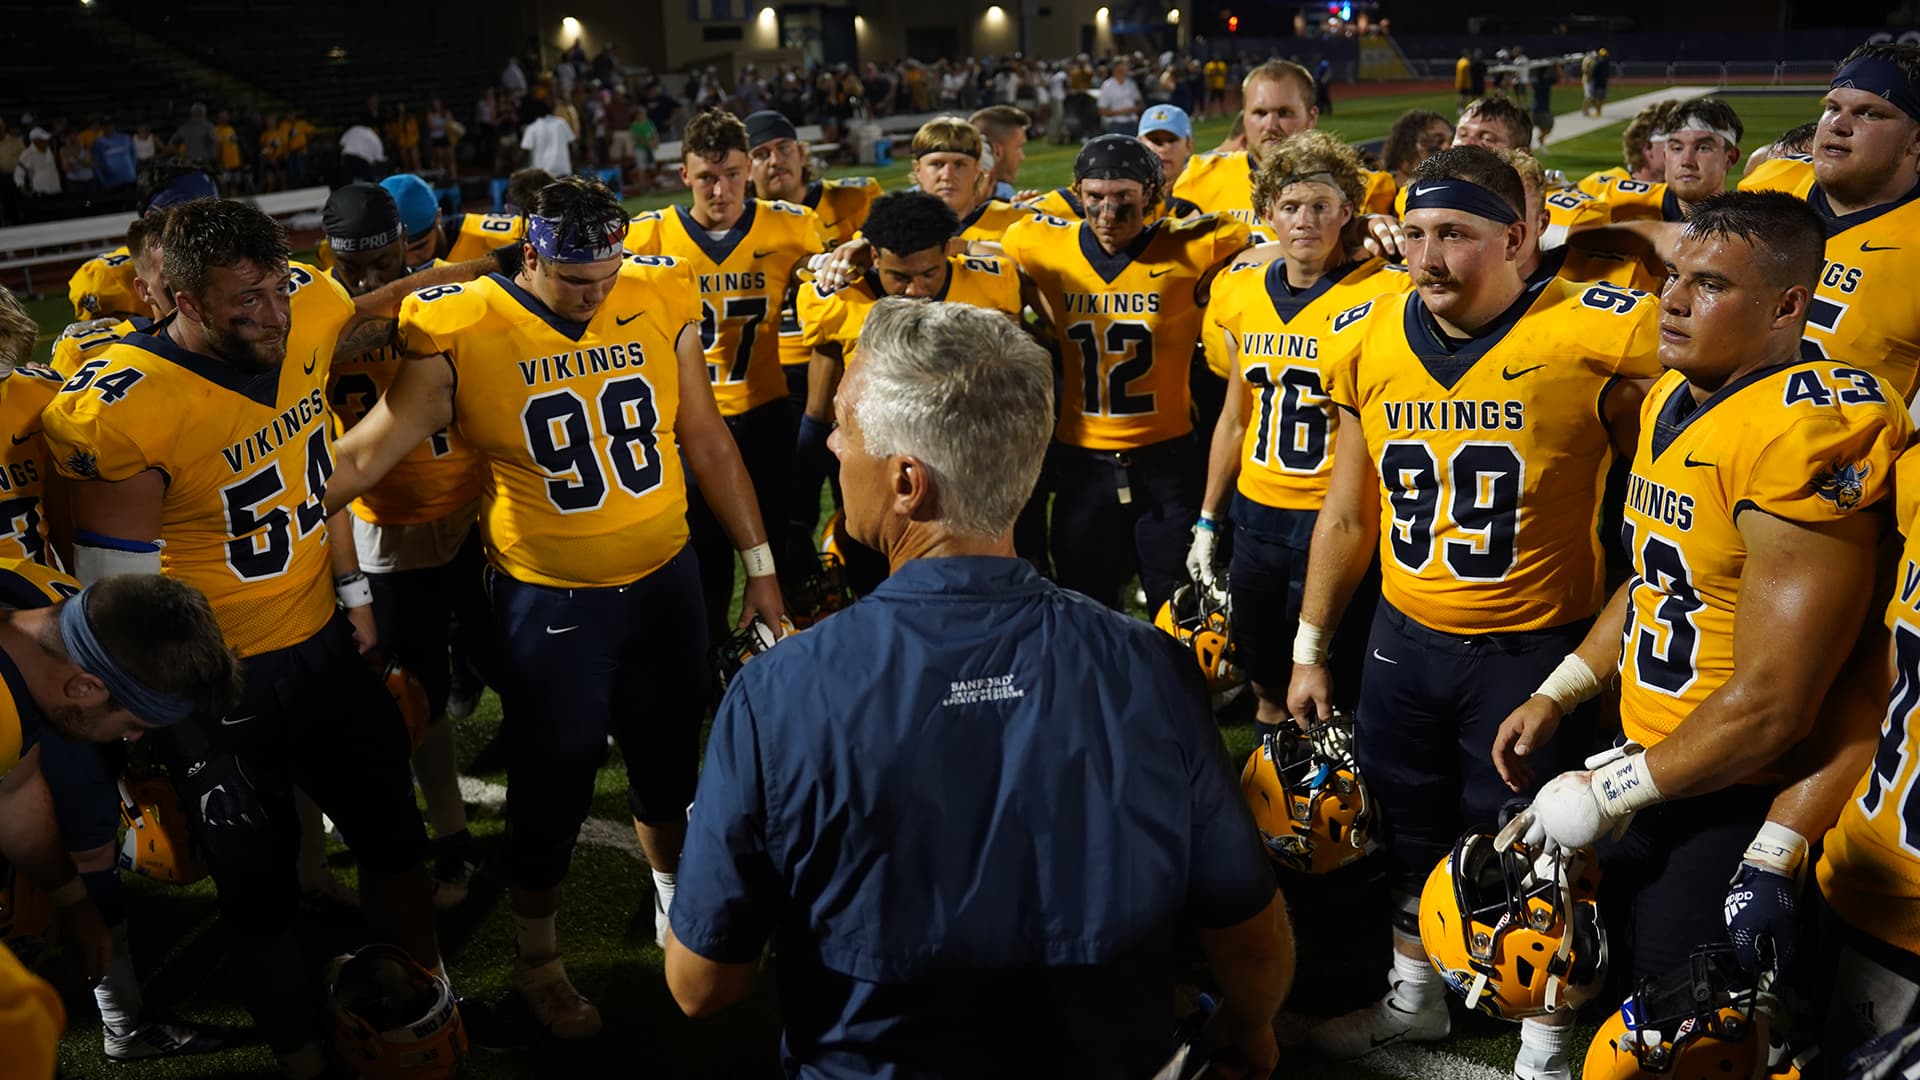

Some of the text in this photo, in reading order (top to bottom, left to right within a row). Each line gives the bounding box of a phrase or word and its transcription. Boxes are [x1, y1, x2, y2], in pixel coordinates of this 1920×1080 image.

[331, 231, 389, 251] NIKE PRO
[1064, 292, 1161, 314] VIKINGS
[60, 359, 147, 406] 54
[518, 341, 646, 387] VIKINGS
[1065, 319, 1159, 418] 12
[1783, 367, 1887, 408] 43
[221, 386, 325, 475] VIKINGS
[1243, 363, 1332, 474] 16
[1383, 399, 1525, 431] VIKINGS
[519, 372, 662, 515] 98
[218, 421, 336, 584] 54
[1378, 440, 1528, 583] 99
[950, 673, 1014, 692] SANFORD
